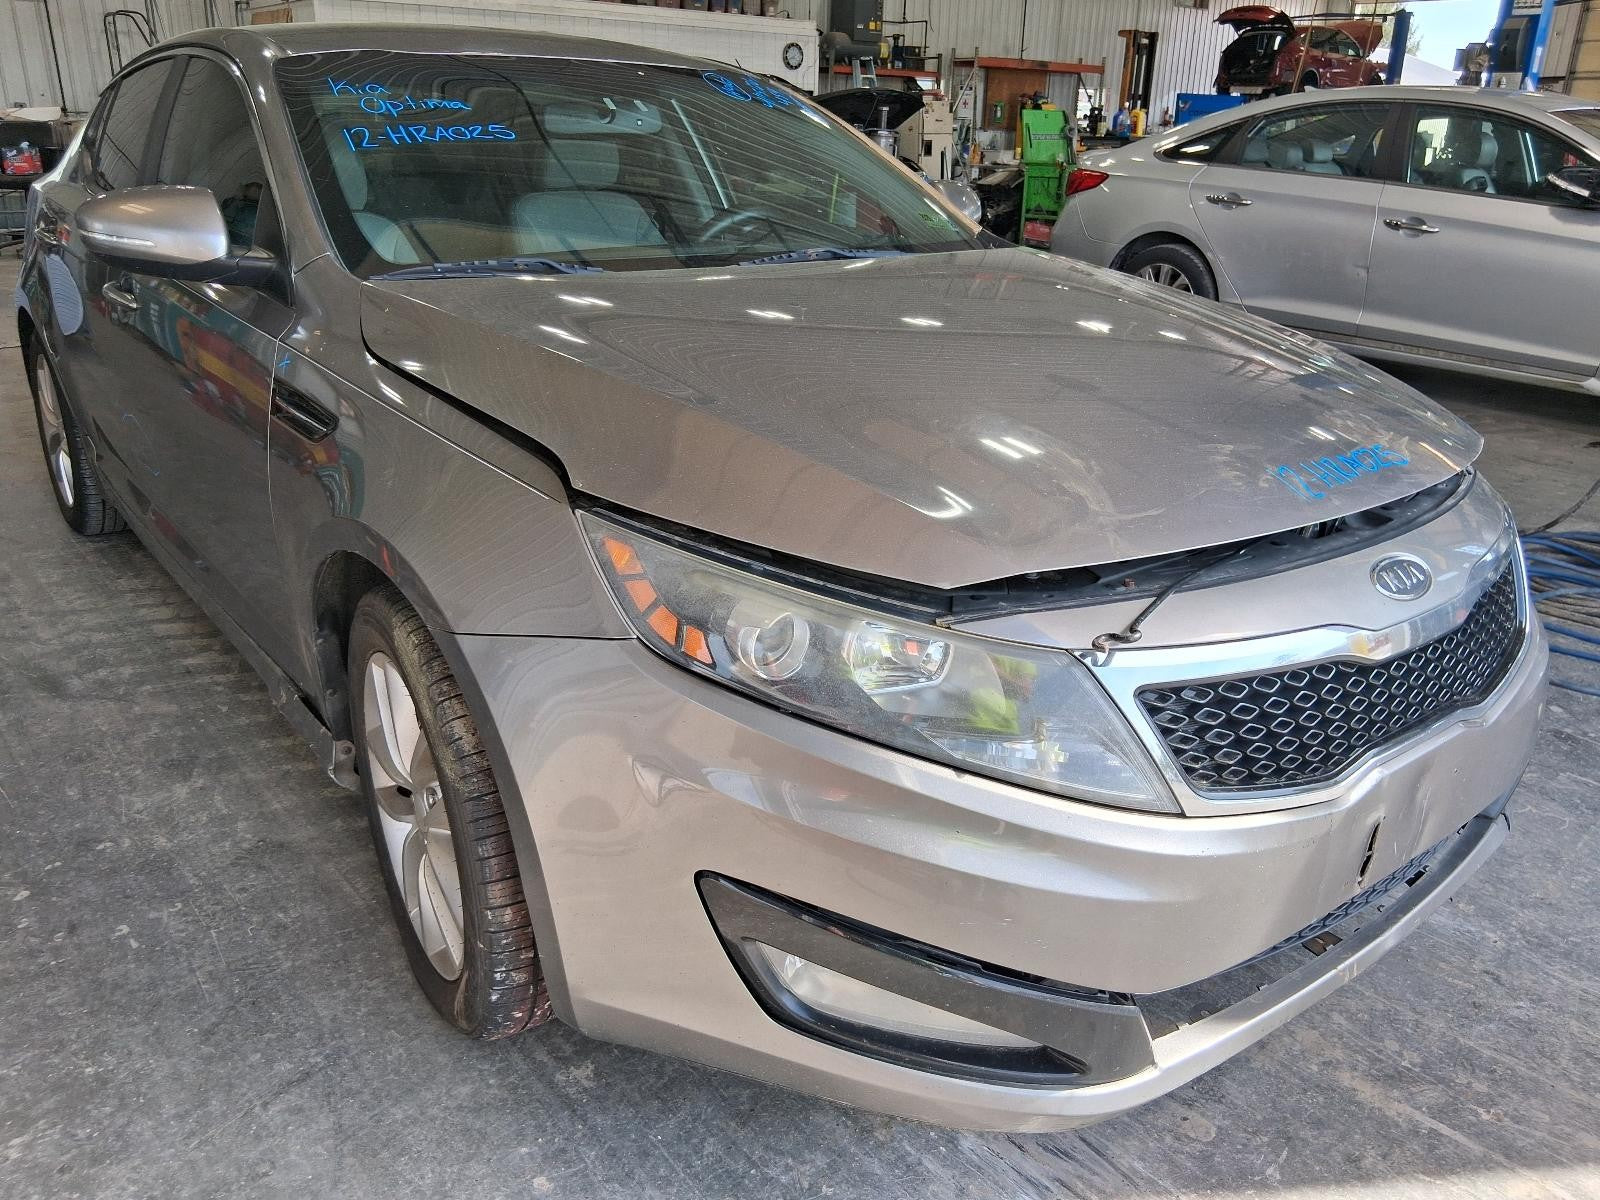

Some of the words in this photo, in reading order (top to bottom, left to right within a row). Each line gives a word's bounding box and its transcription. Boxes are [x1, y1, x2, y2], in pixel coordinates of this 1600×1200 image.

[328, 77, 392, 97] Kia
[360, 95, 472, 118] Optima
[343, 123, 516, 152] 12-HRA025
[1379, 561, 1425, 593] KIA
